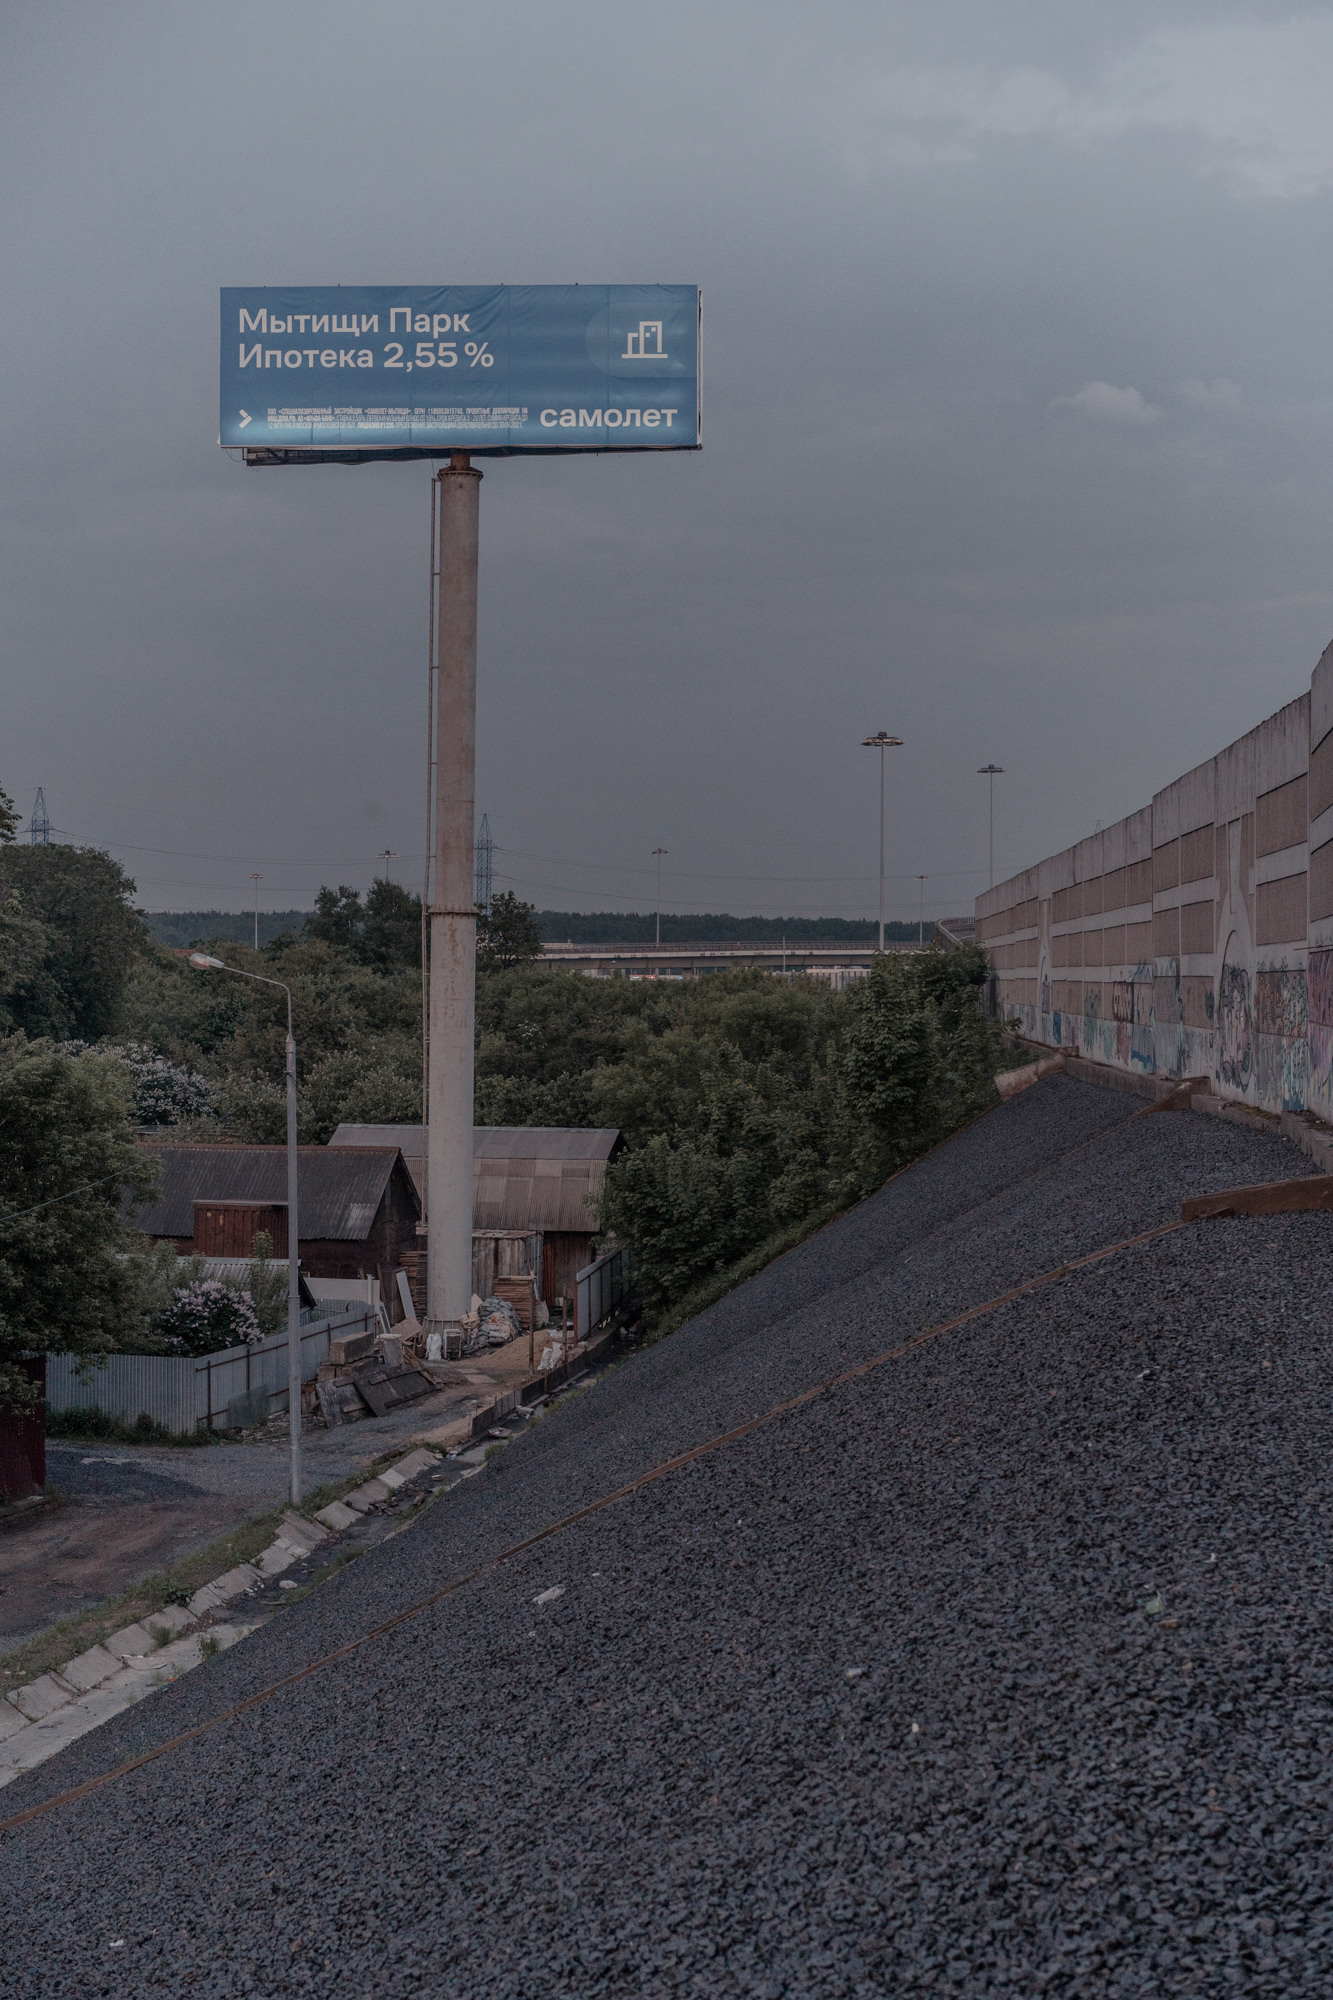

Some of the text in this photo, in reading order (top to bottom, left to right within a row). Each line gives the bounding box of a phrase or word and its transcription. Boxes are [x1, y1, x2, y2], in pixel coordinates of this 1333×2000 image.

[239, 307, 471, 340] Мытищи Парк
[238, 341, 495, 373] Ипотека 2,55 %
[539, 408, 678, 428] самолет
